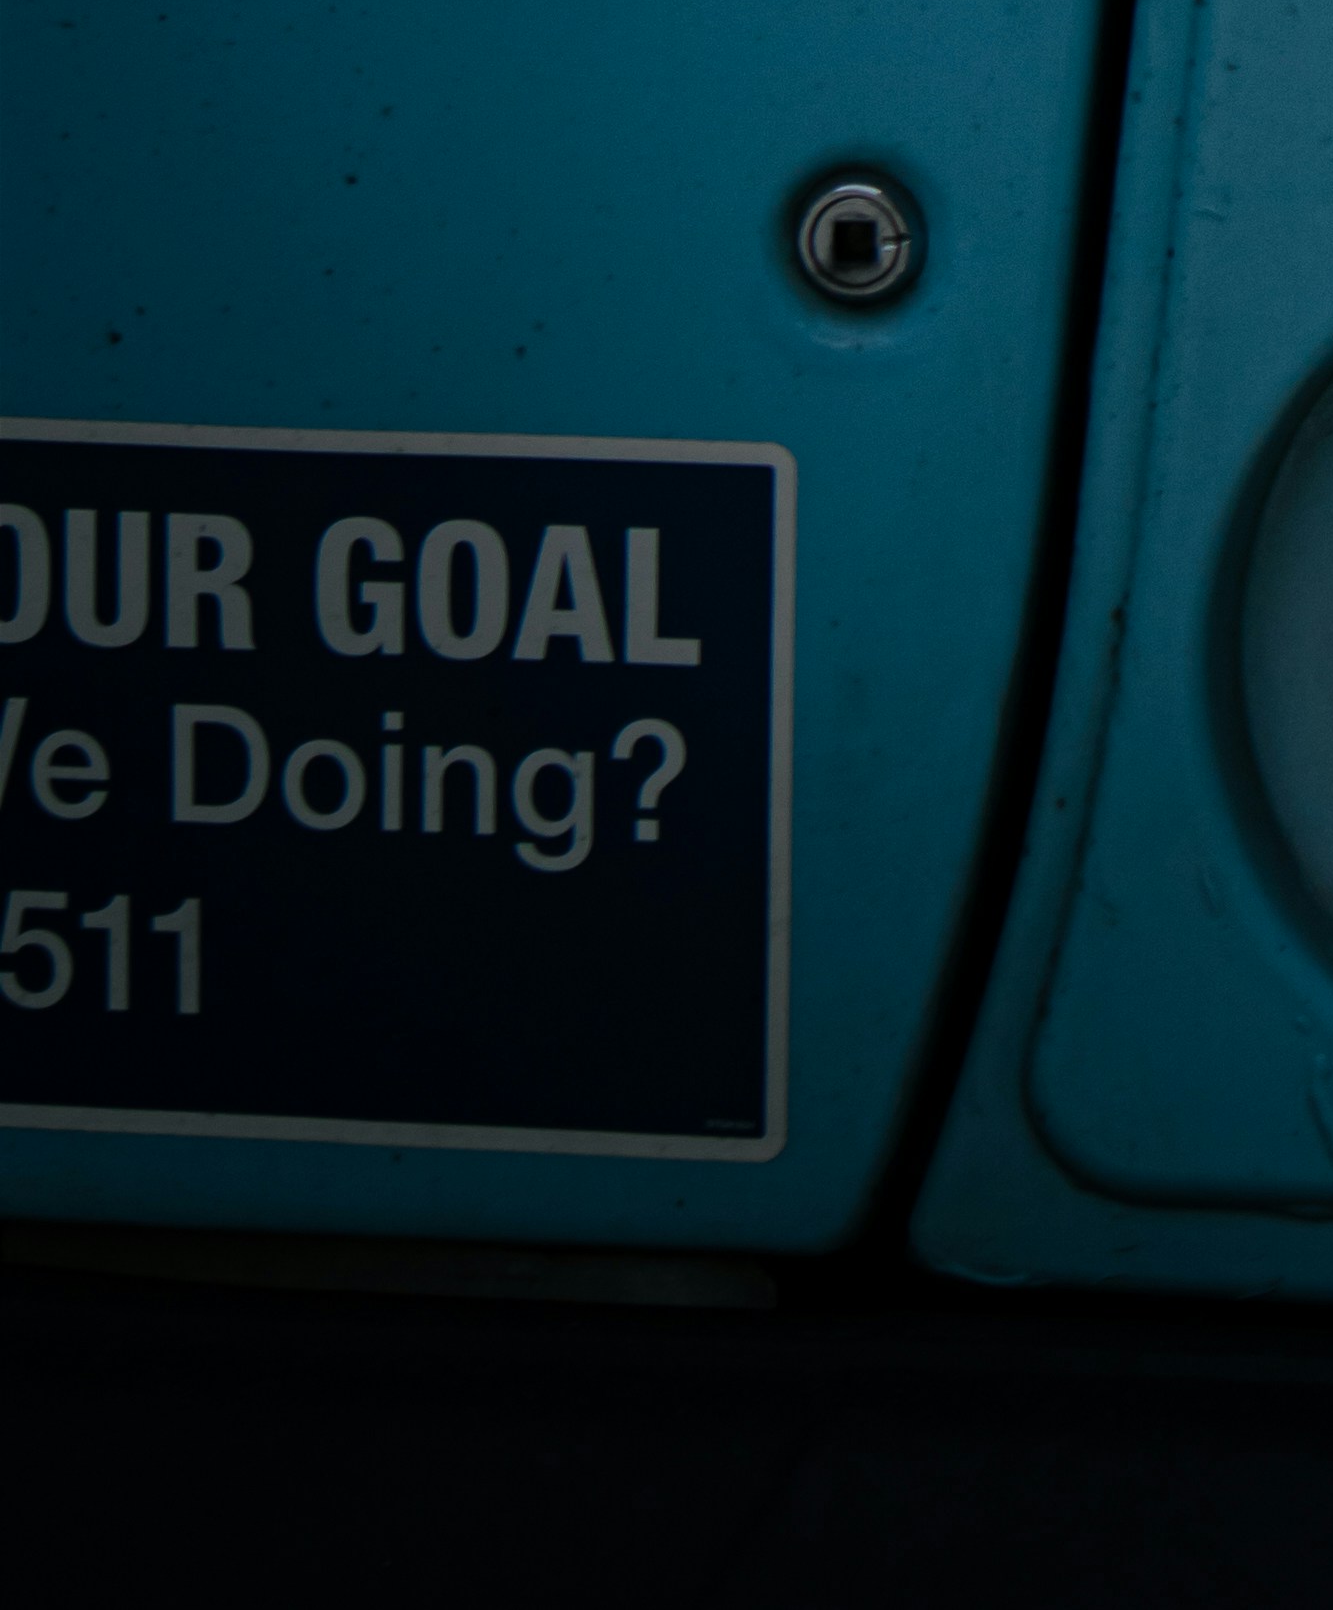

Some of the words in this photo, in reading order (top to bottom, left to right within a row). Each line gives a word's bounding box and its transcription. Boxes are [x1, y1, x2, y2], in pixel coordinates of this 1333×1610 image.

[0, 502, 257, 651] OUR
[314, 515, 703, 667] GOAL
[0, 696, 111, 821] e
[170, 703, 688, 873] Doing?
[0, 889, 203, 1016] 511
